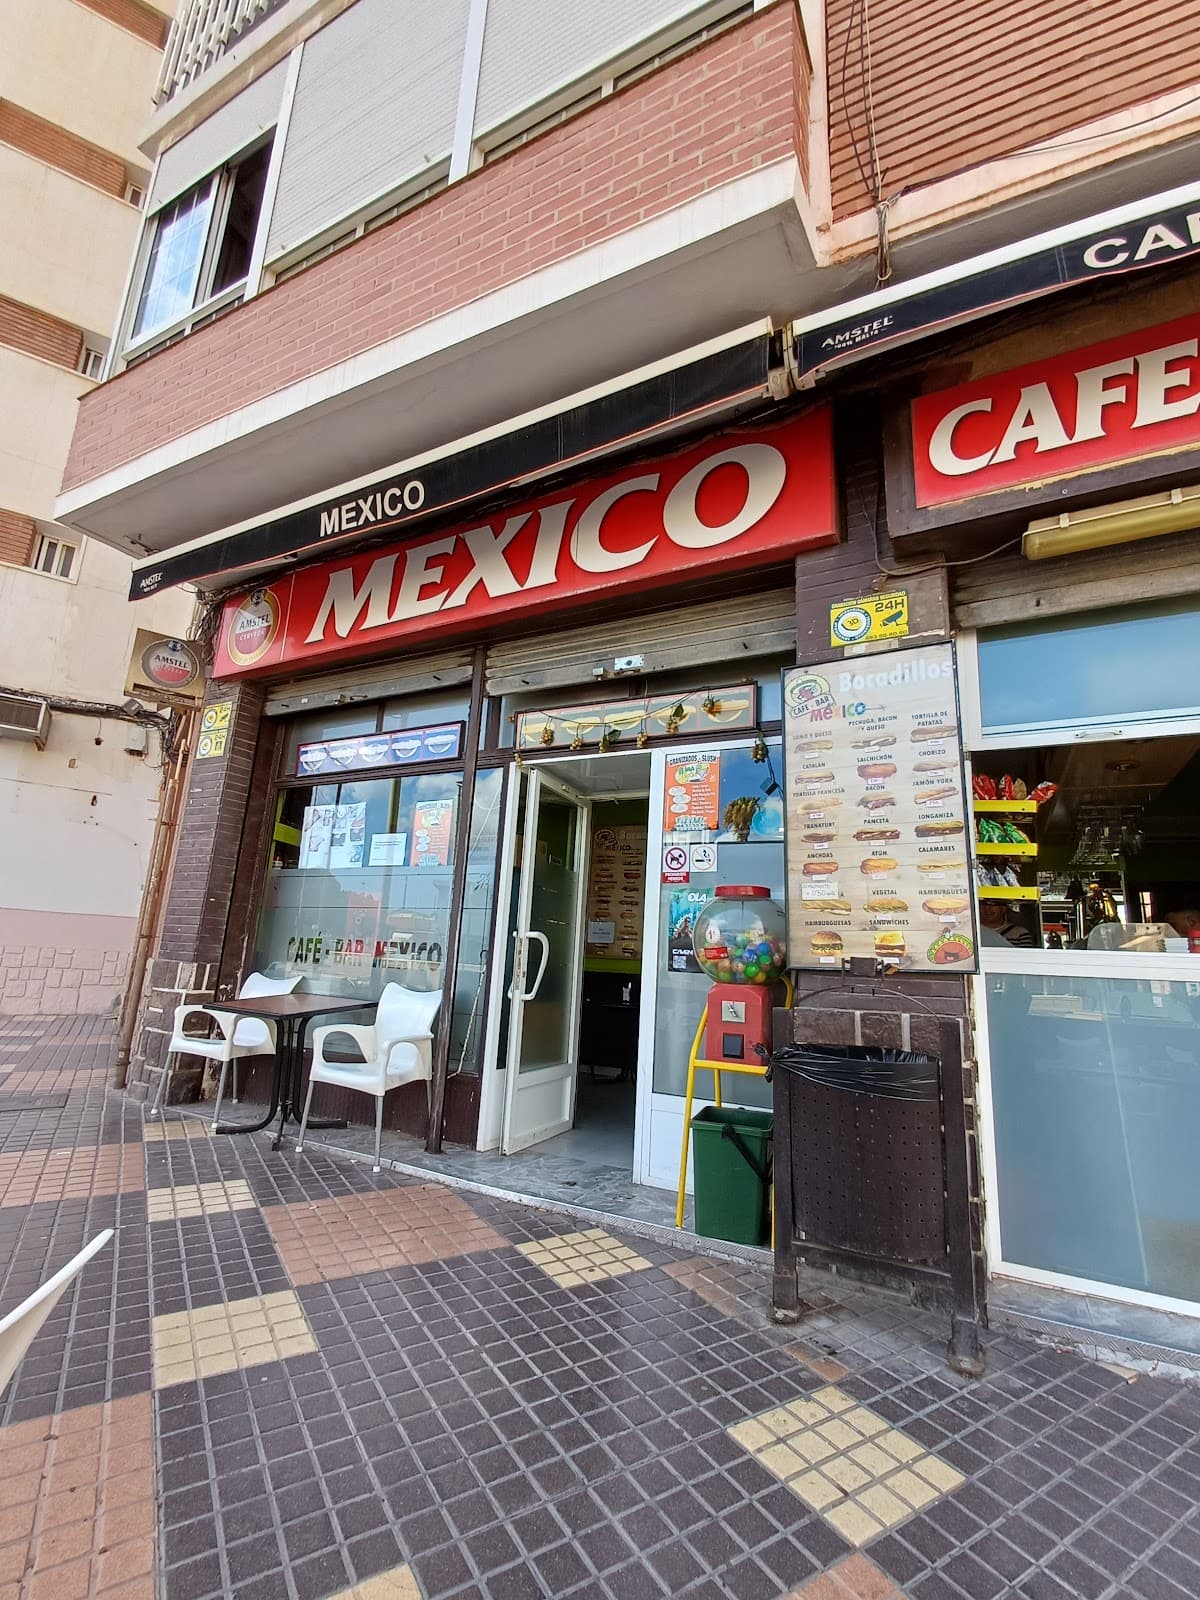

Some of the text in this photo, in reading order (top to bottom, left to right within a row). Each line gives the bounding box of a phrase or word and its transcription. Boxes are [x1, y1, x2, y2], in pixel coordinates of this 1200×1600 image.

[820, 315, 894, 348] AMSTEL
[855, 329, 879, 342] MALTA
[928, 338, 1200, 476] CAFE
[319, 480, 425, 537] MEXICO
[303, 443, 787, 645] MEXICO
[140, 572, 163, 588] AMSTEL
[875, 598, 904, 613] 24H
[239, 613, 271, 631] AMSTEL
[154, 654, 189, 669] AMSTEL
[839, 658, 950, 692] Bocadillos
[815, 696, 829, 706] BAR
[877, 714, 898, 723] BACON
[917, 719, 943, 727] PATATAS
[866, 724, 885, 732] QUESO
[918, 749, 946, 757] CHORIZO
[918, 812, 954, 820] LONGANIZA
[918, 845, 955, 853] CALAMARES
[286, 931, 323, 963] CAFÉ
